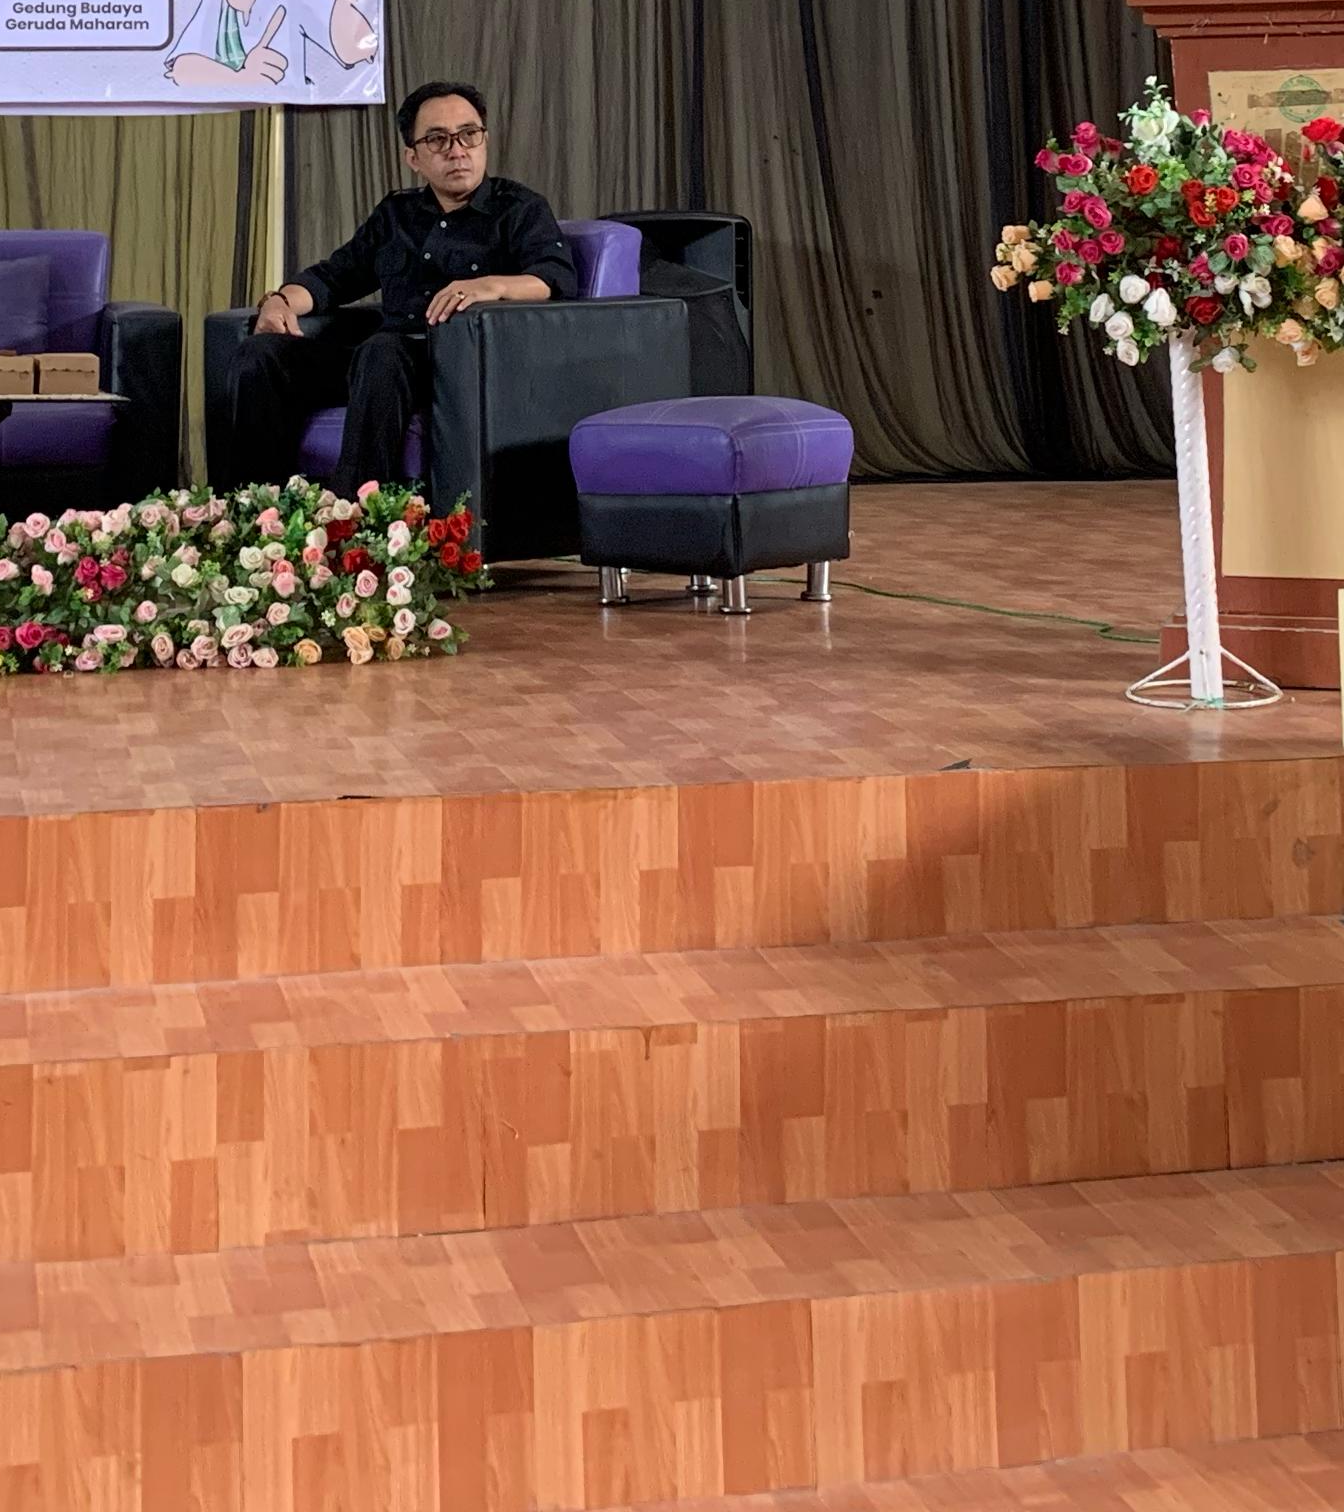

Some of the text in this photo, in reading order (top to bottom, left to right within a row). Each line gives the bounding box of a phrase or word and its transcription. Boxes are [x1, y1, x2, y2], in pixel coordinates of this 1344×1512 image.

[12, 1, 143, 18] Gedung Budaya
[5, 18, 150, 32] Geruda Maharam
